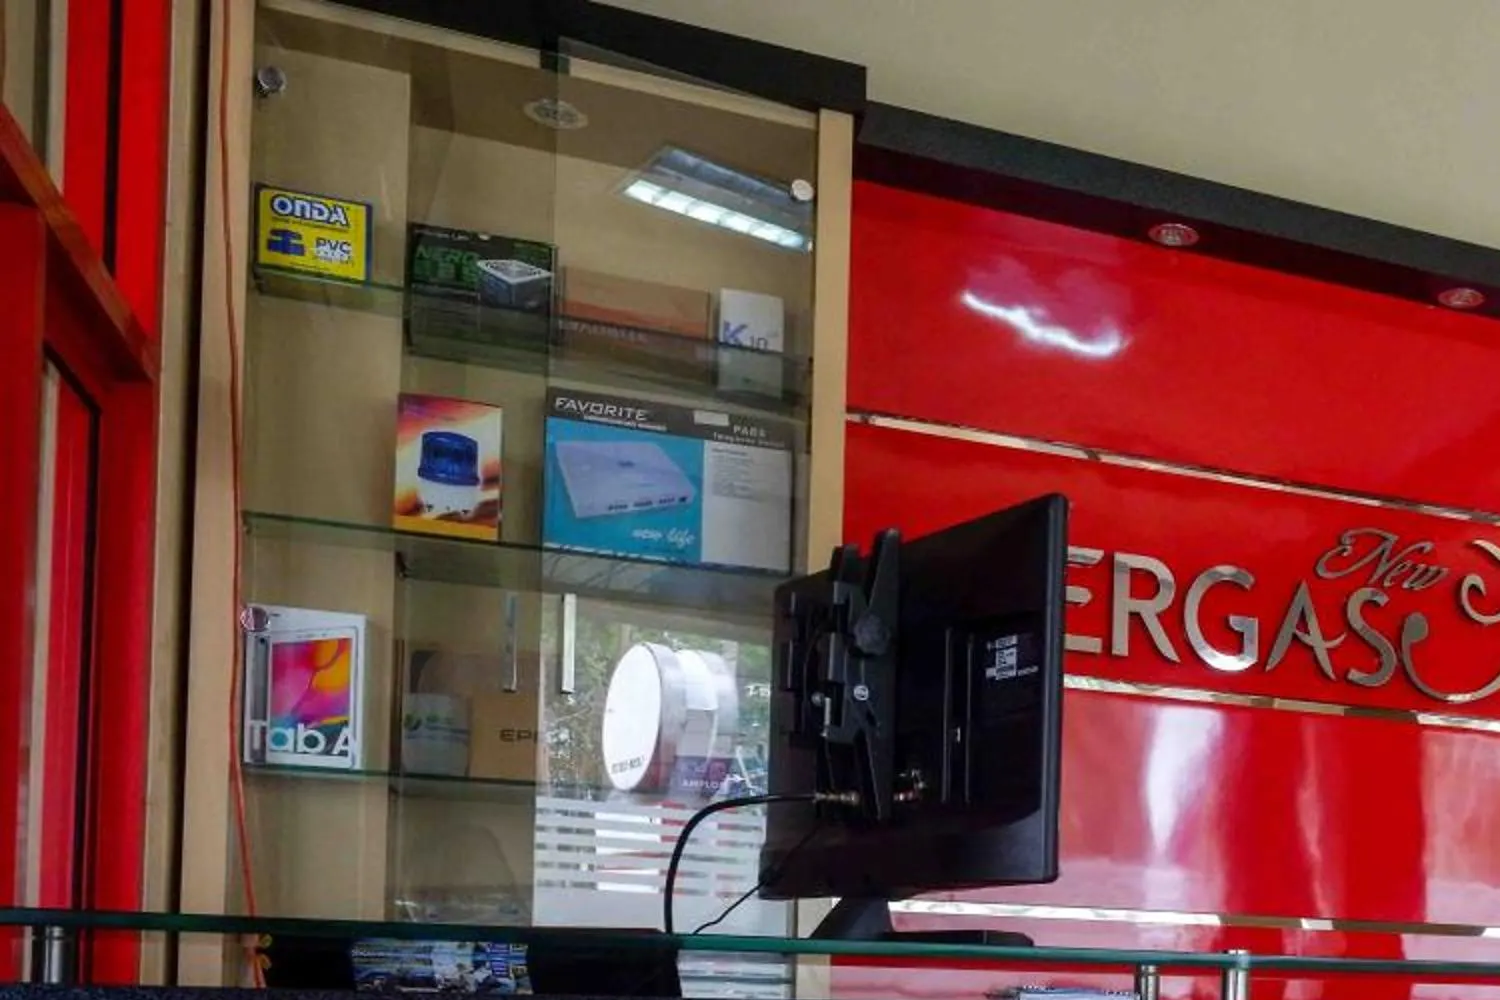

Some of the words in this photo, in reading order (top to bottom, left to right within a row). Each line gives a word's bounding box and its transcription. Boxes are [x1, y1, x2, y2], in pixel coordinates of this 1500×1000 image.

[555, 397, 648, 421] FAVORITE
[1315, 527, 1449, 590] New
[1063, 545, 1398, 688] ERGAS
